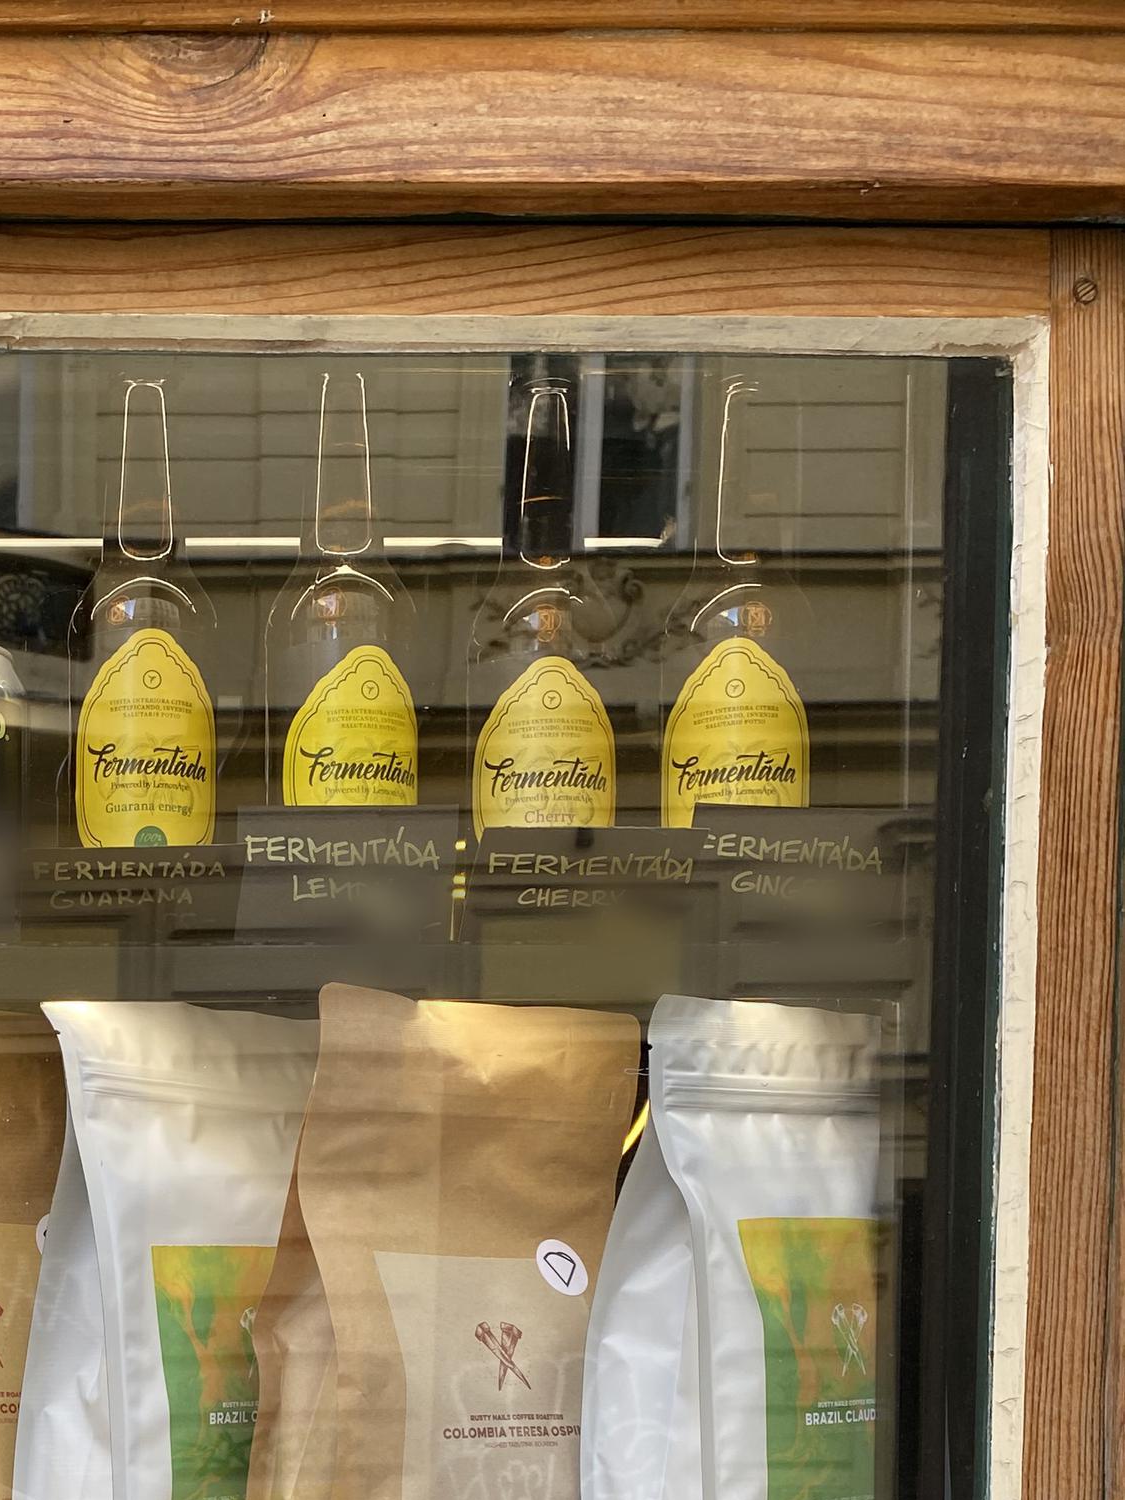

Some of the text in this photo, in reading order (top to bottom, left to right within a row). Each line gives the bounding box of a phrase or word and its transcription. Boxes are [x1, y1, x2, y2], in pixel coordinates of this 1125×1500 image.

[88, 743, 207, 783] Fermentáda
[484, 757, 607, 798] Fermentáda
[672, 750, 796, 796] Fermentáda
[525, 810, 576, 825] Cherry
[244, 826, 440, 871] FERMENTÁDA
[31, 852, 226, 882] FERMENTÁDA
[488, 848, 694, 884] FERMENTÁDA
[0, 1403, 19, 1414] CO
[209, 1411, 248, 1425] BRAZIL
[805, 1411, 843, 1426] BRAZIL
[443, 1427, 507, 1440] COLOMBIA
[509, 1426, 549, 1437] TERESA
